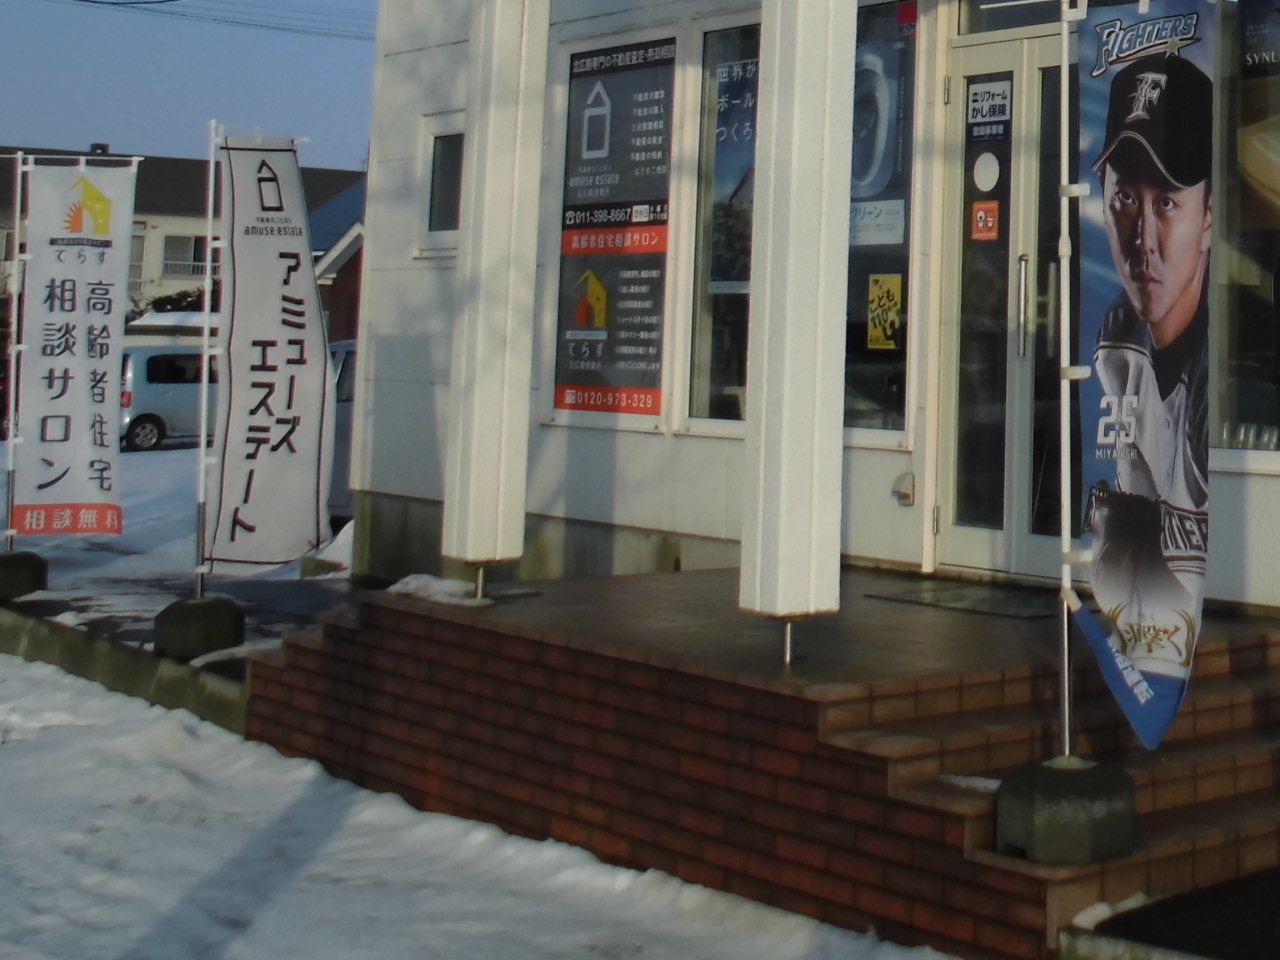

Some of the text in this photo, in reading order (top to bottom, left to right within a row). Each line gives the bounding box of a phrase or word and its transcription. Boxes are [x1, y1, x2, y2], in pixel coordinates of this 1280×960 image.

[1091, 13, 1198, 77] FIGHTERS
[55, 248, 106, 265] てらす
[244, 225, 303, 237] amuse estate
[37, 278, 77, 490] 相談サロン
[270, 252, 308, 454] アミューズ
[87, 279, 115, 492] 高齢者住宅
[230, 339, 279, 542] エステート
[1097, 395, 1139, 444] 25
[24, 508, 118, 531] 相談無料
